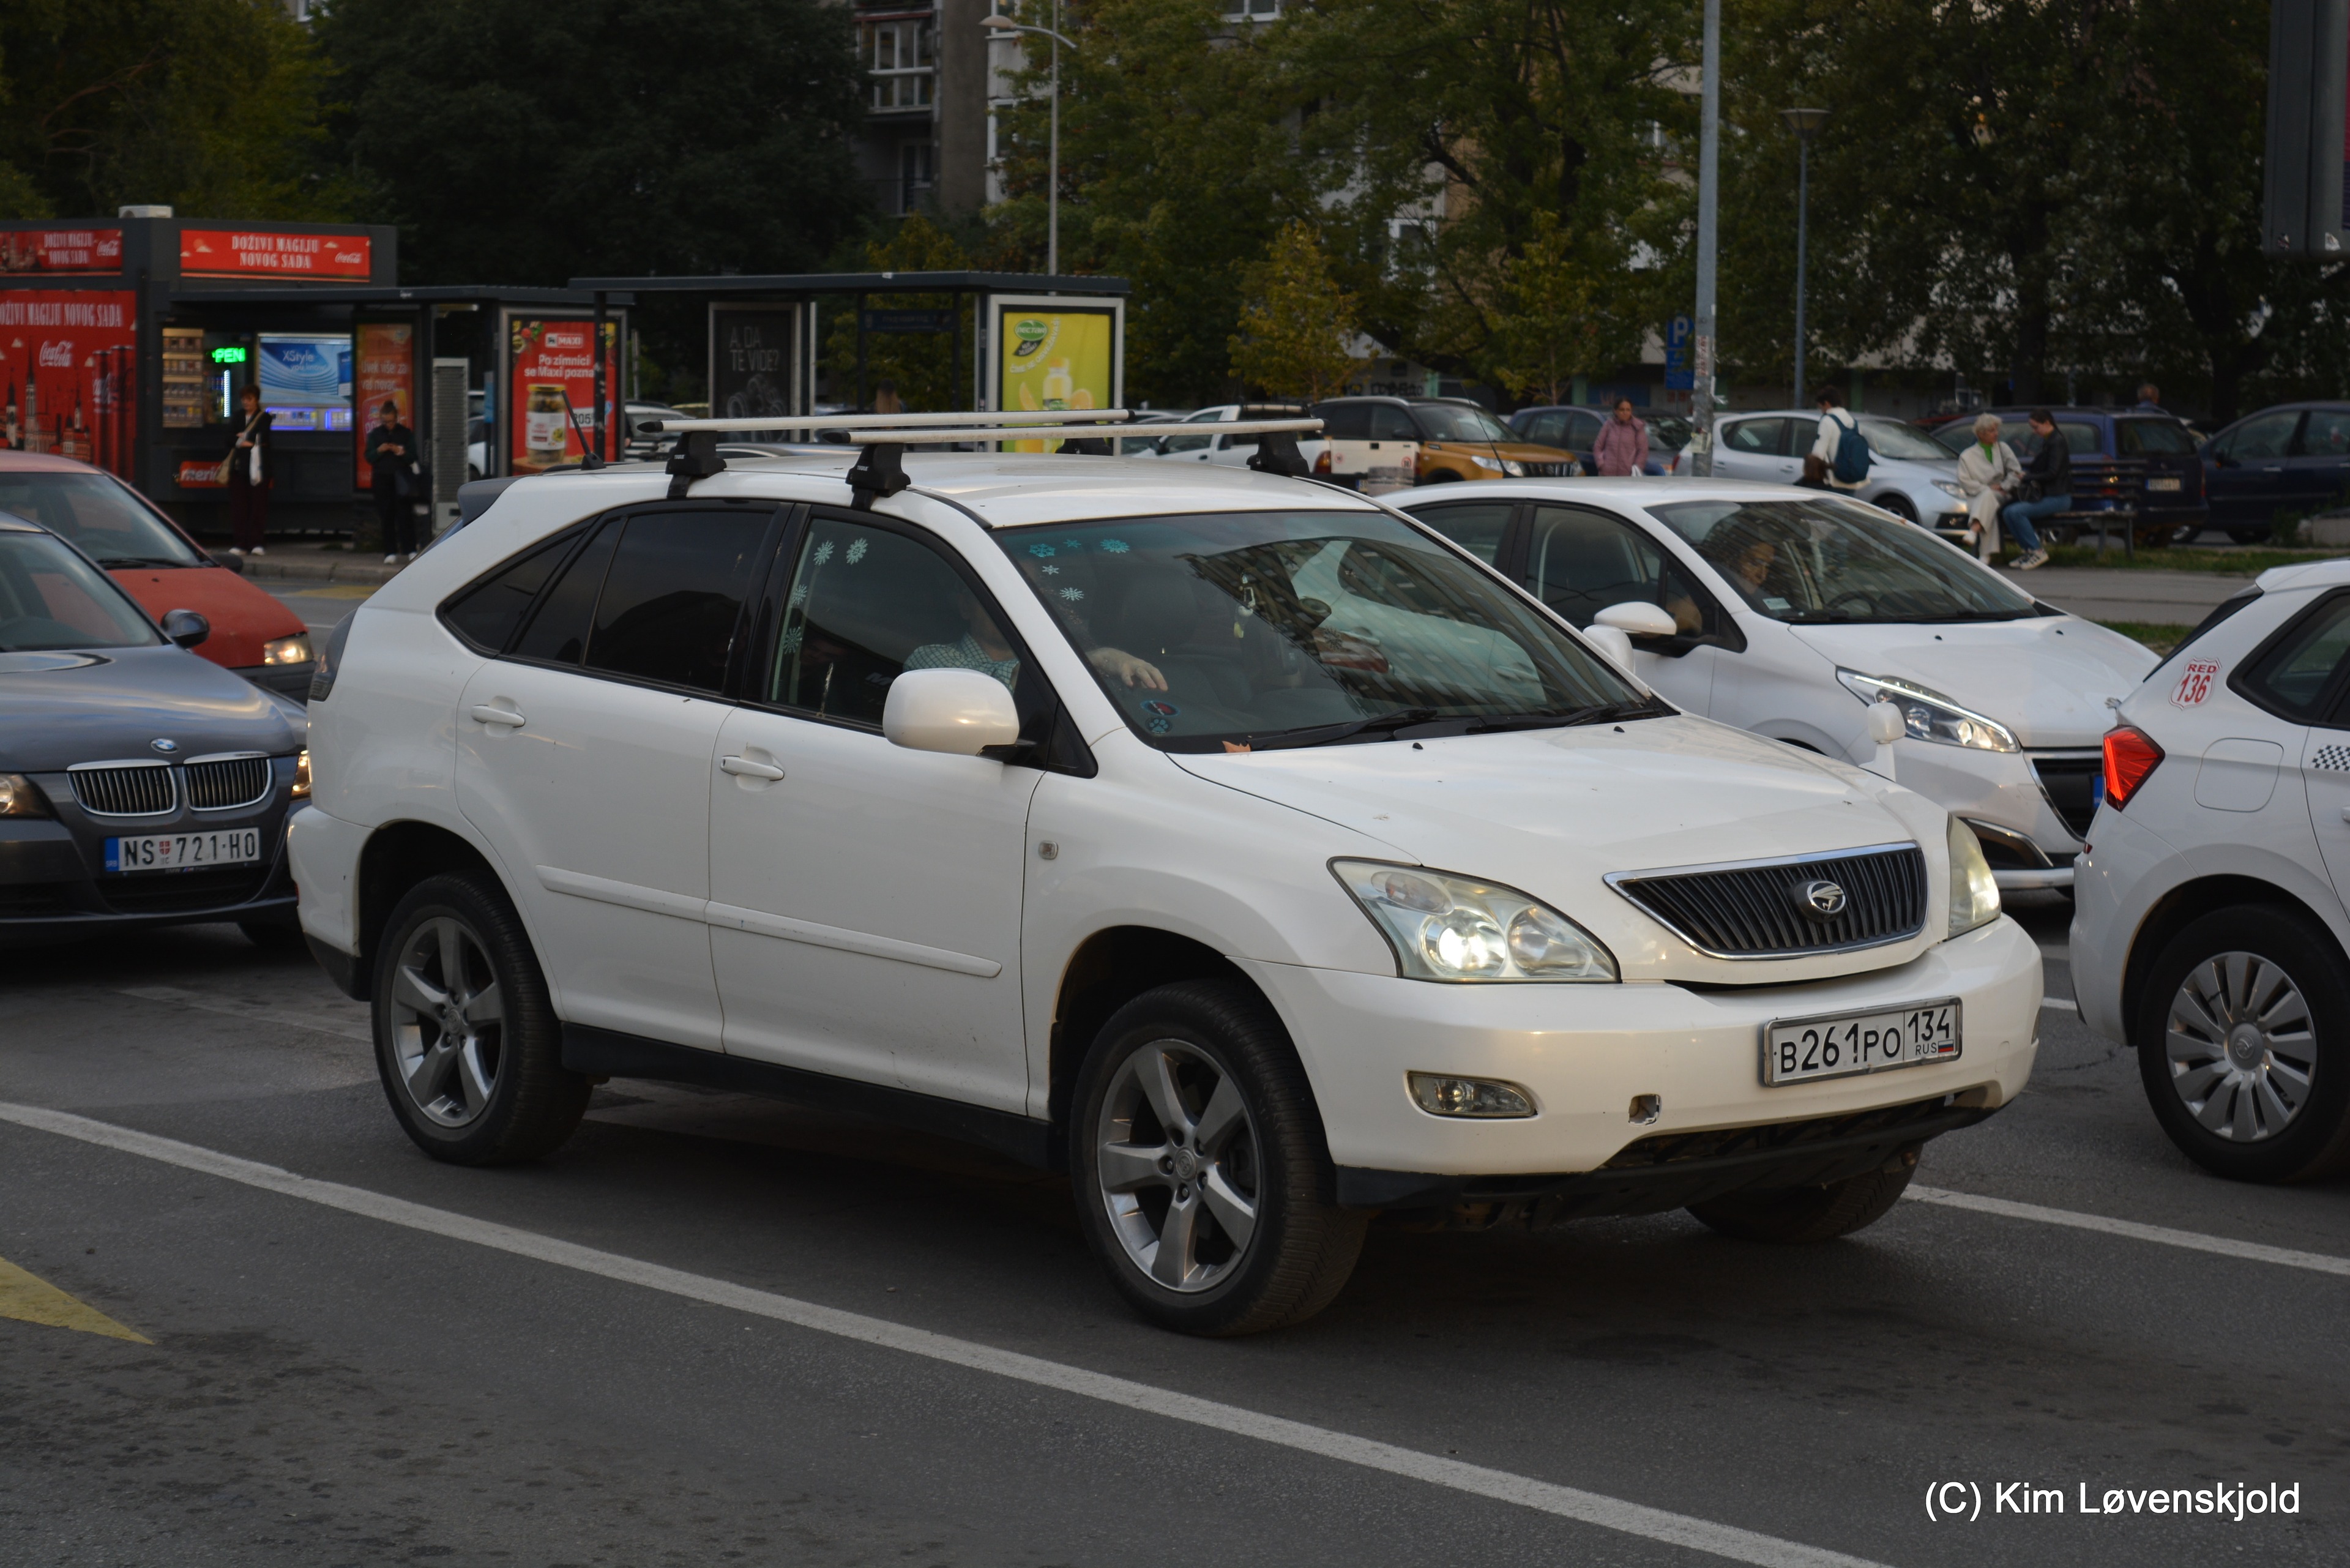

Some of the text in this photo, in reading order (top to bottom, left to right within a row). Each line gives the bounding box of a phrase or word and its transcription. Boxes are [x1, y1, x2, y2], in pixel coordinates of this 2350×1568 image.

[231, 234, 319, 253] DOŽIVI MAGIJU
[239, 252, 312, 269] NOVOG SADA
[64, 302, 95, 327] NOVOG
[97, 304, 123, 327] SADA
[1673, 316, 1689, 345] P
[558, 337, 582, 345] MAXI
[212, 347, 246, 364] PEN
[539, 354, 591, 366] Po zimnici
[524, 365, 595, 380] se Maxi pozna
[2187, 663, 2217, 673] RED
[2176, 673, 2211, 704] 136
[124, 839, 154, 867] NS
[1908, 1009, 1950, 1043] 134
[1915, 1042, 1938, 1056] RUS
